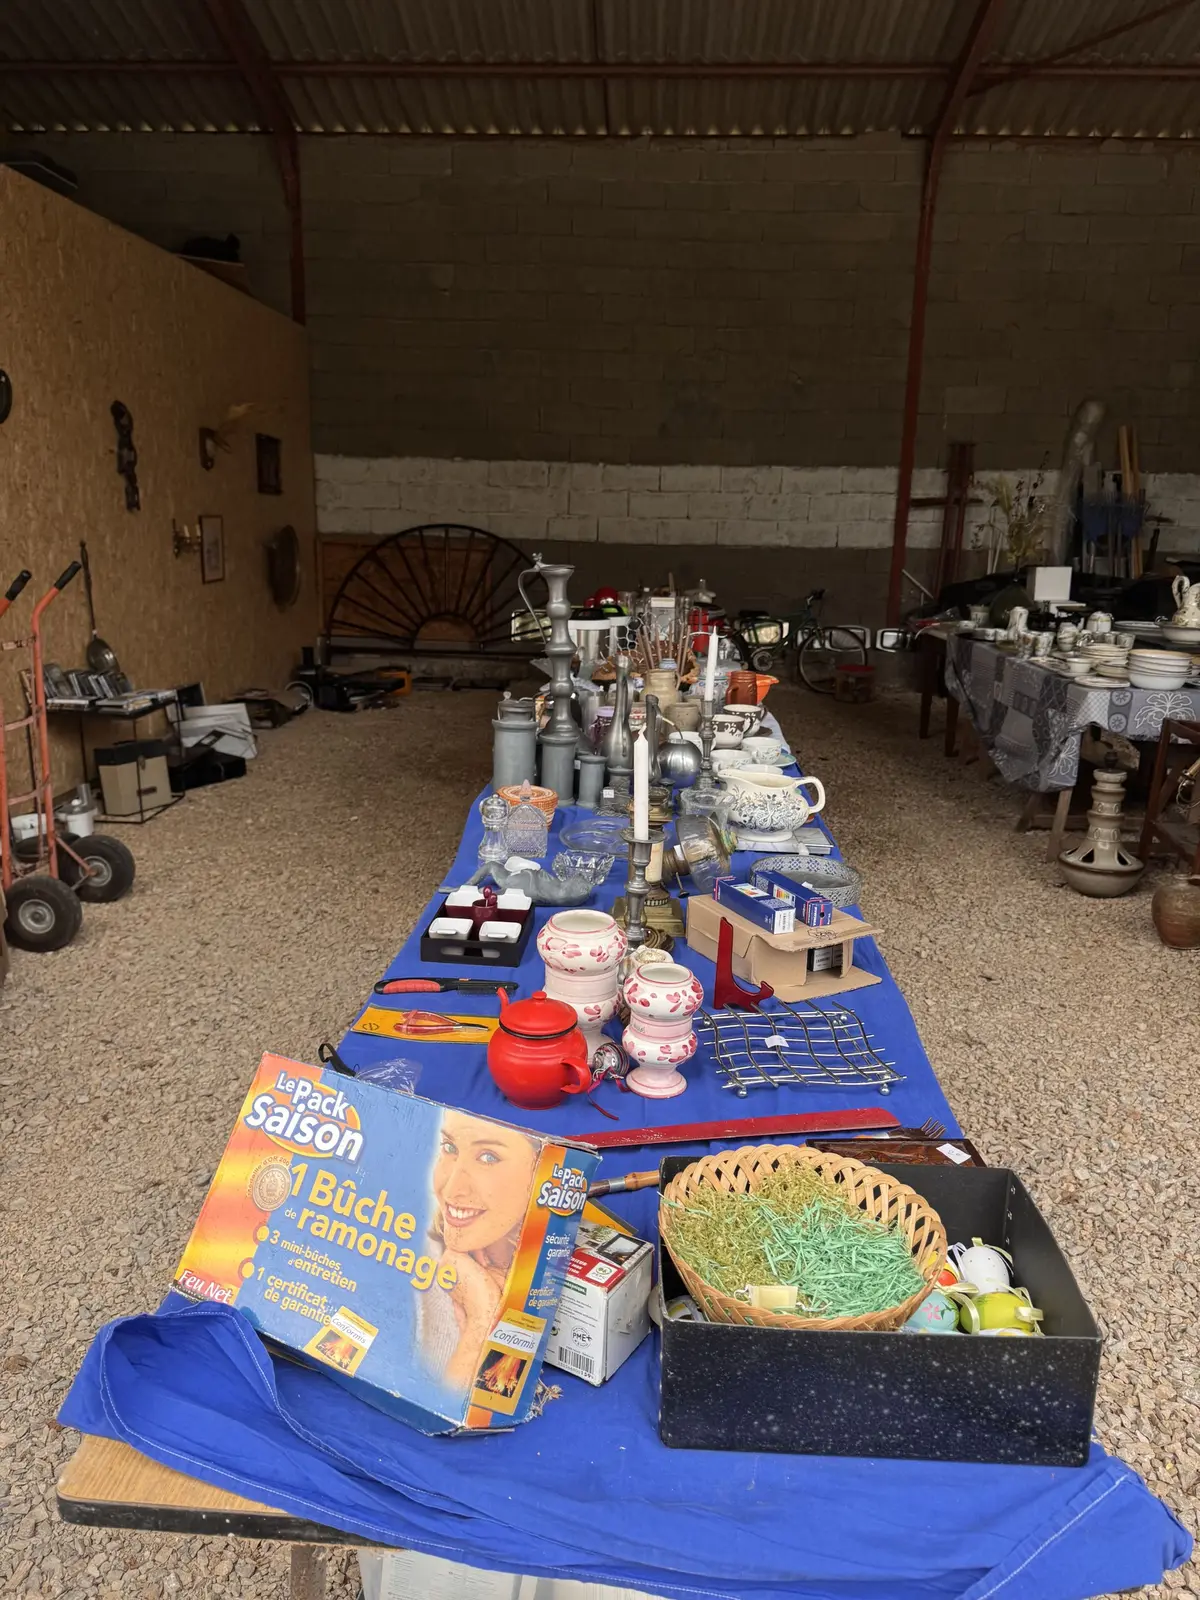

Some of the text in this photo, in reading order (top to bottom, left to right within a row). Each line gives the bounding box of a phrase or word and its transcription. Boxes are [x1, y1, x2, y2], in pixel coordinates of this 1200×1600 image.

[276, 1072, 350, 1121] Le Pack
[245, 1095, 364, 1161] Saison
[537, 1181, 587, 1211] Saison
[553, 1164, 587, 1189] Le Pack
[291, 1162, 417, 1240] 1 Bûche
[269, 1229, 342, 1271] 3 mini-bûches
[284, 1207, 458, 1291] de ramonage
[178, 1269, 205, 1292] Feu
[204, 1281, 233, 1305] Net
[256, 1266, 328, 1310] 1 certificat
[287, 1257, 358, 1293] d'entretien
[264, 1287, 280, 1303] de
[280, 1296, 332, 1327] garantie
[493, 1329, 536, 1350] Conformis
